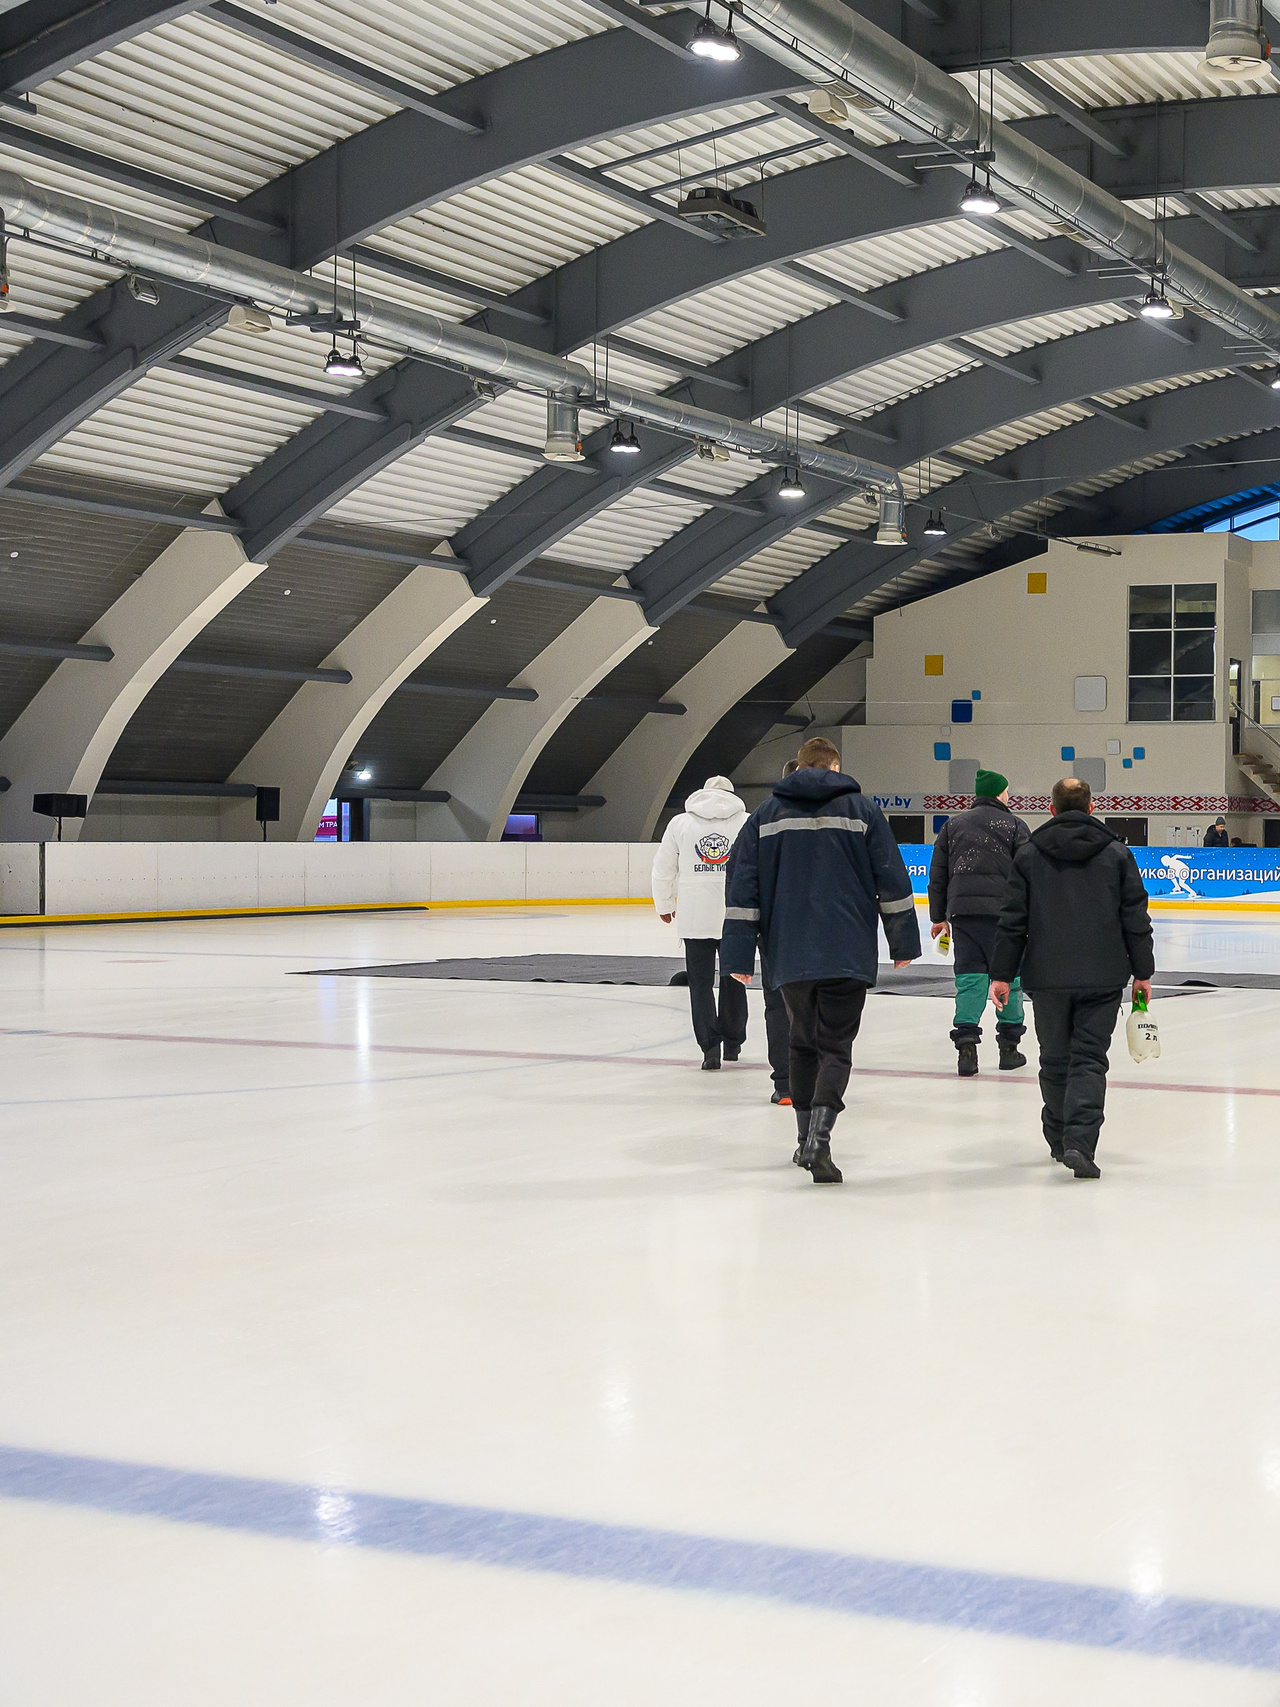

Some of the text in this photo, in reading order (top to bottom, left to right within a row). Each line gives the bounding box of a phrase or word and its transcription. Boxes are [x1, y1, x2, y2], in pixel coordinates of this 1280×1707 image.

[694, 864, 715, 872] БЕЛЫЕ
[904, 865, 927, 877] яя
[1145, 1032, 1151, 1041] 2
